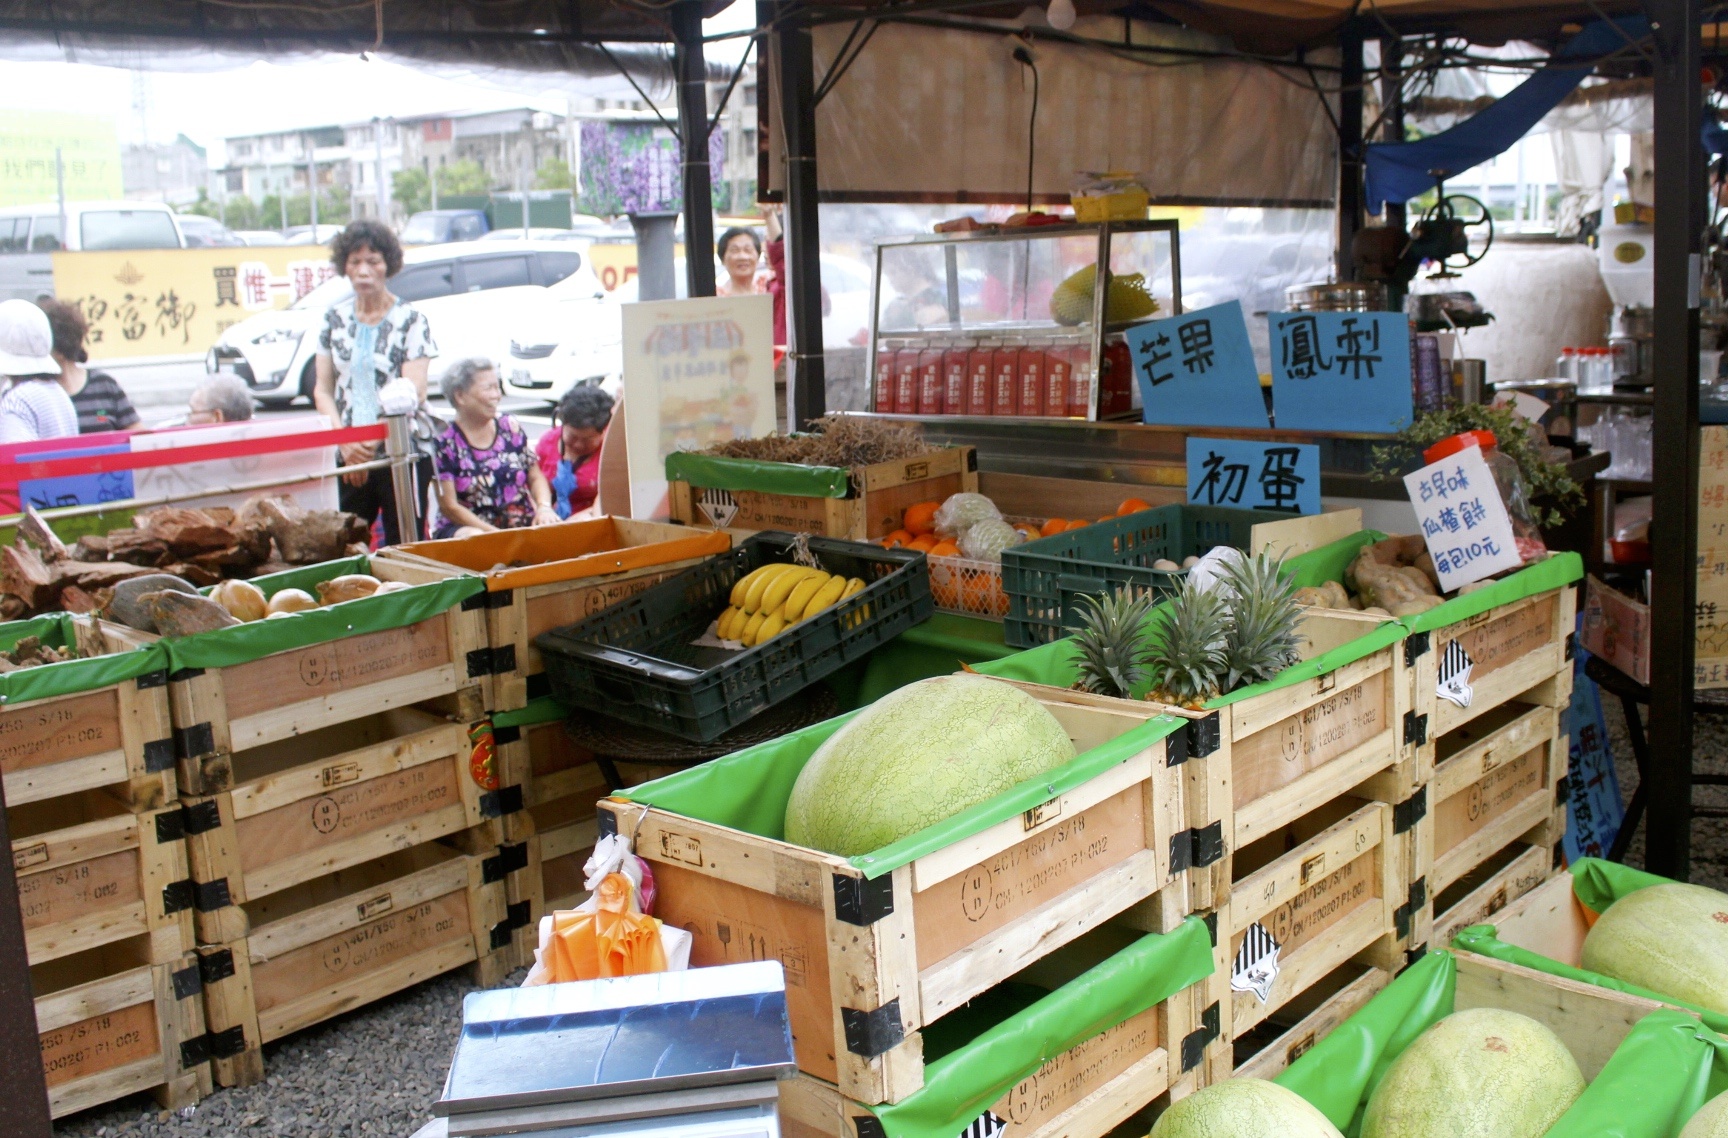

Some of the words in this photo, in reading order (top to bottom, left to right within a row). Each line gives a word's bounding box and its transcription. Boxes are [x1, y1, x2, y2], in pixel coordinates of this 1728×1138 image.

[1140, 318, 1214, 387] 芒果
[1278, 315, 1382, 380] 鳳梨
[1191, 447, 1306, 514] 初蛋
[1419, 466, 1469, 503] 古早味
[1423, 497, 1486, 538] 仙楂餅
